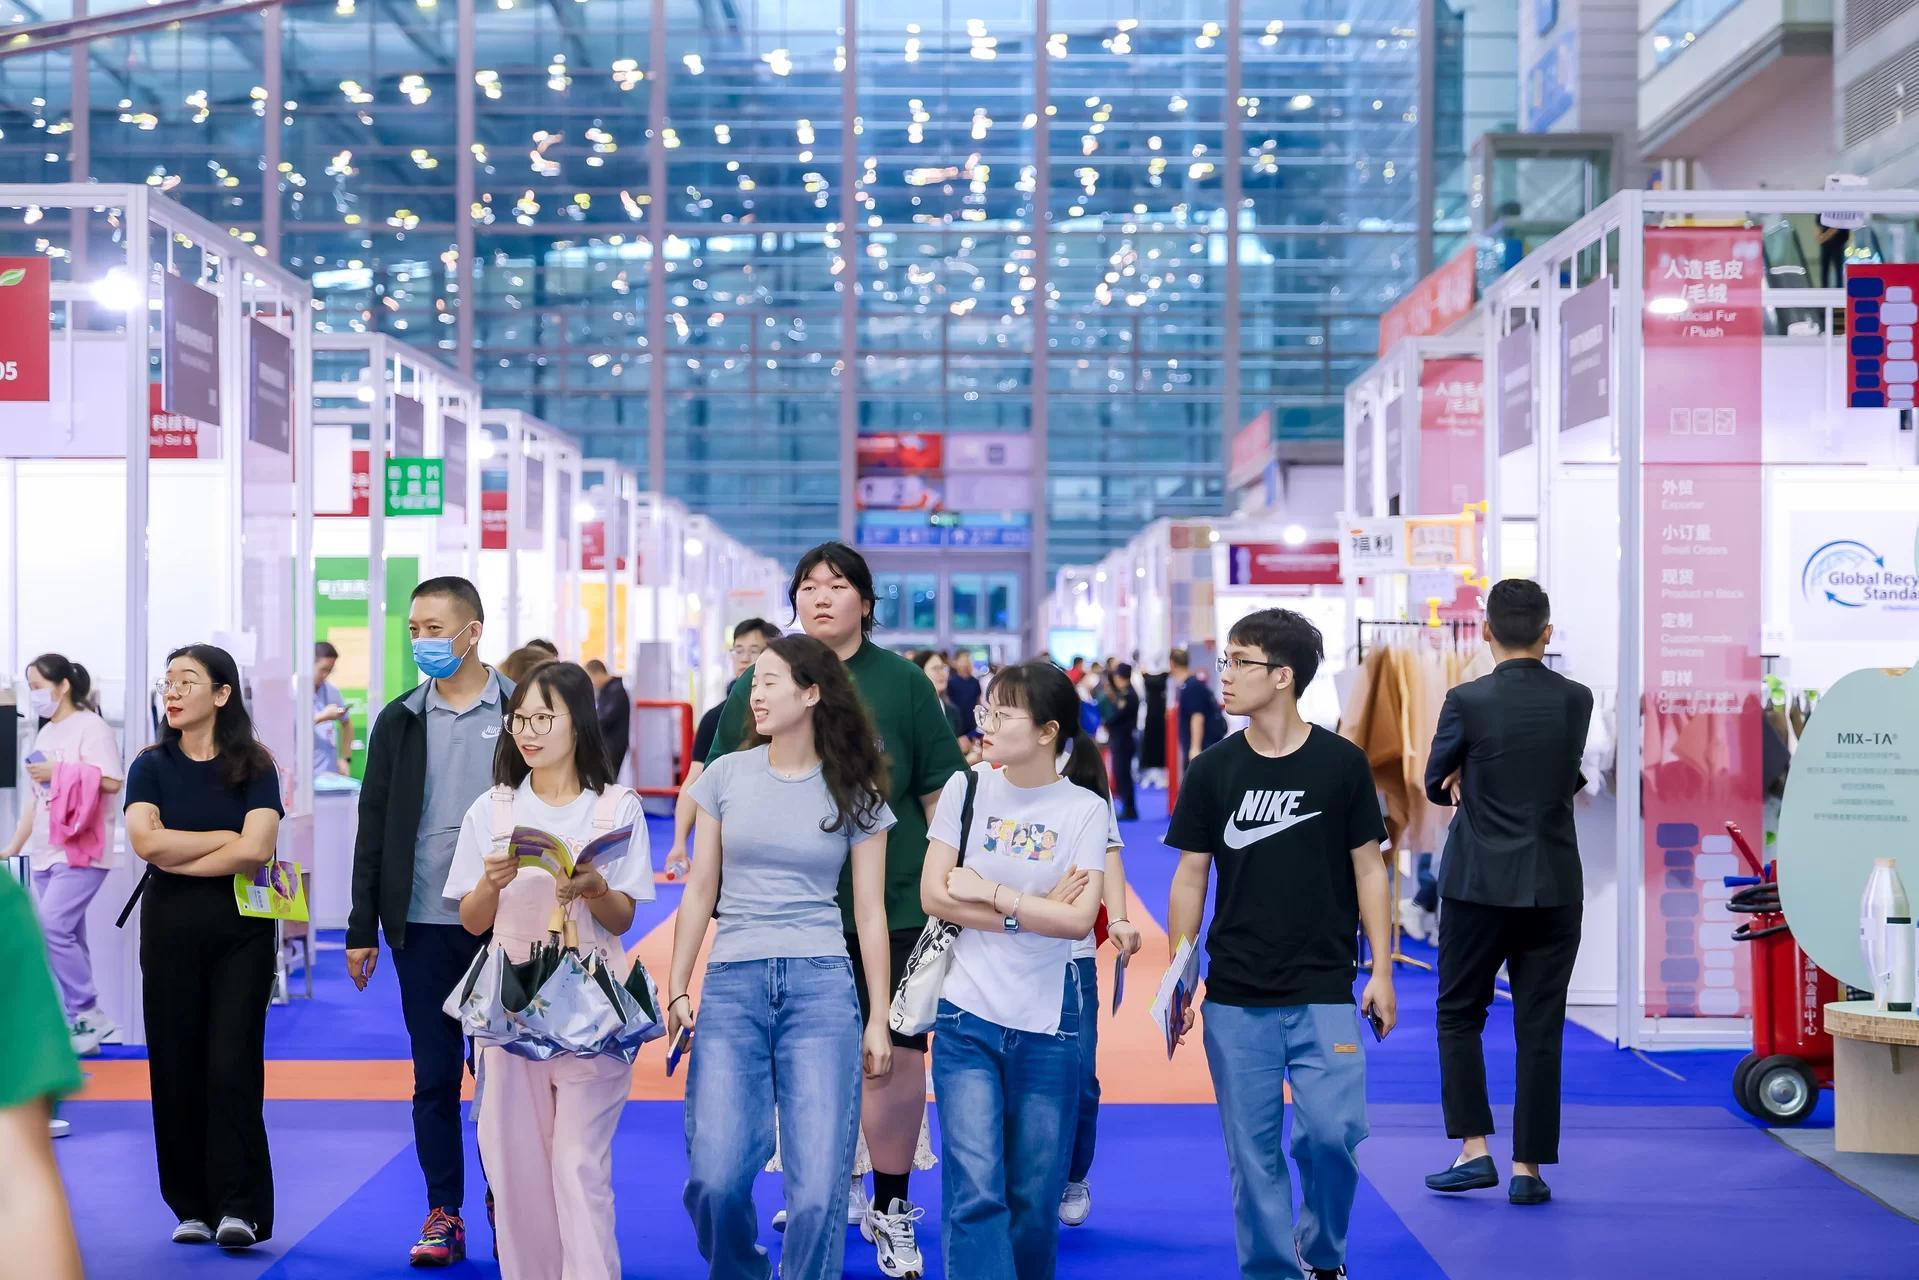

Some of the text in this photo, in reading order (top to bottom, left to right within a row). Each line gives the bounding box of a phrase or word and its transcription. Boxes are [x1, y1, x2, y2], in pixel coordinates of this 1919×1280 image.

[1664, 259, 1743, 280] 人造毛皮
[1716, 310, 1737, 321] Fur
[1690, 326, 1724, 337] Plush
[1662, 480, 1694, 496] 外贸
[1662, 524, 1711, 541] 小订量
[1352, 535, 1393, 552] 福利
[1662, 568, 1694, 585] 现货
[1828, 571, 1879, 586] Global
[1661, 612, 1693, 628] 定制
[1661, 670, 1693, 687] 剪样
[1236, 790, 1306, 822] NIKE
